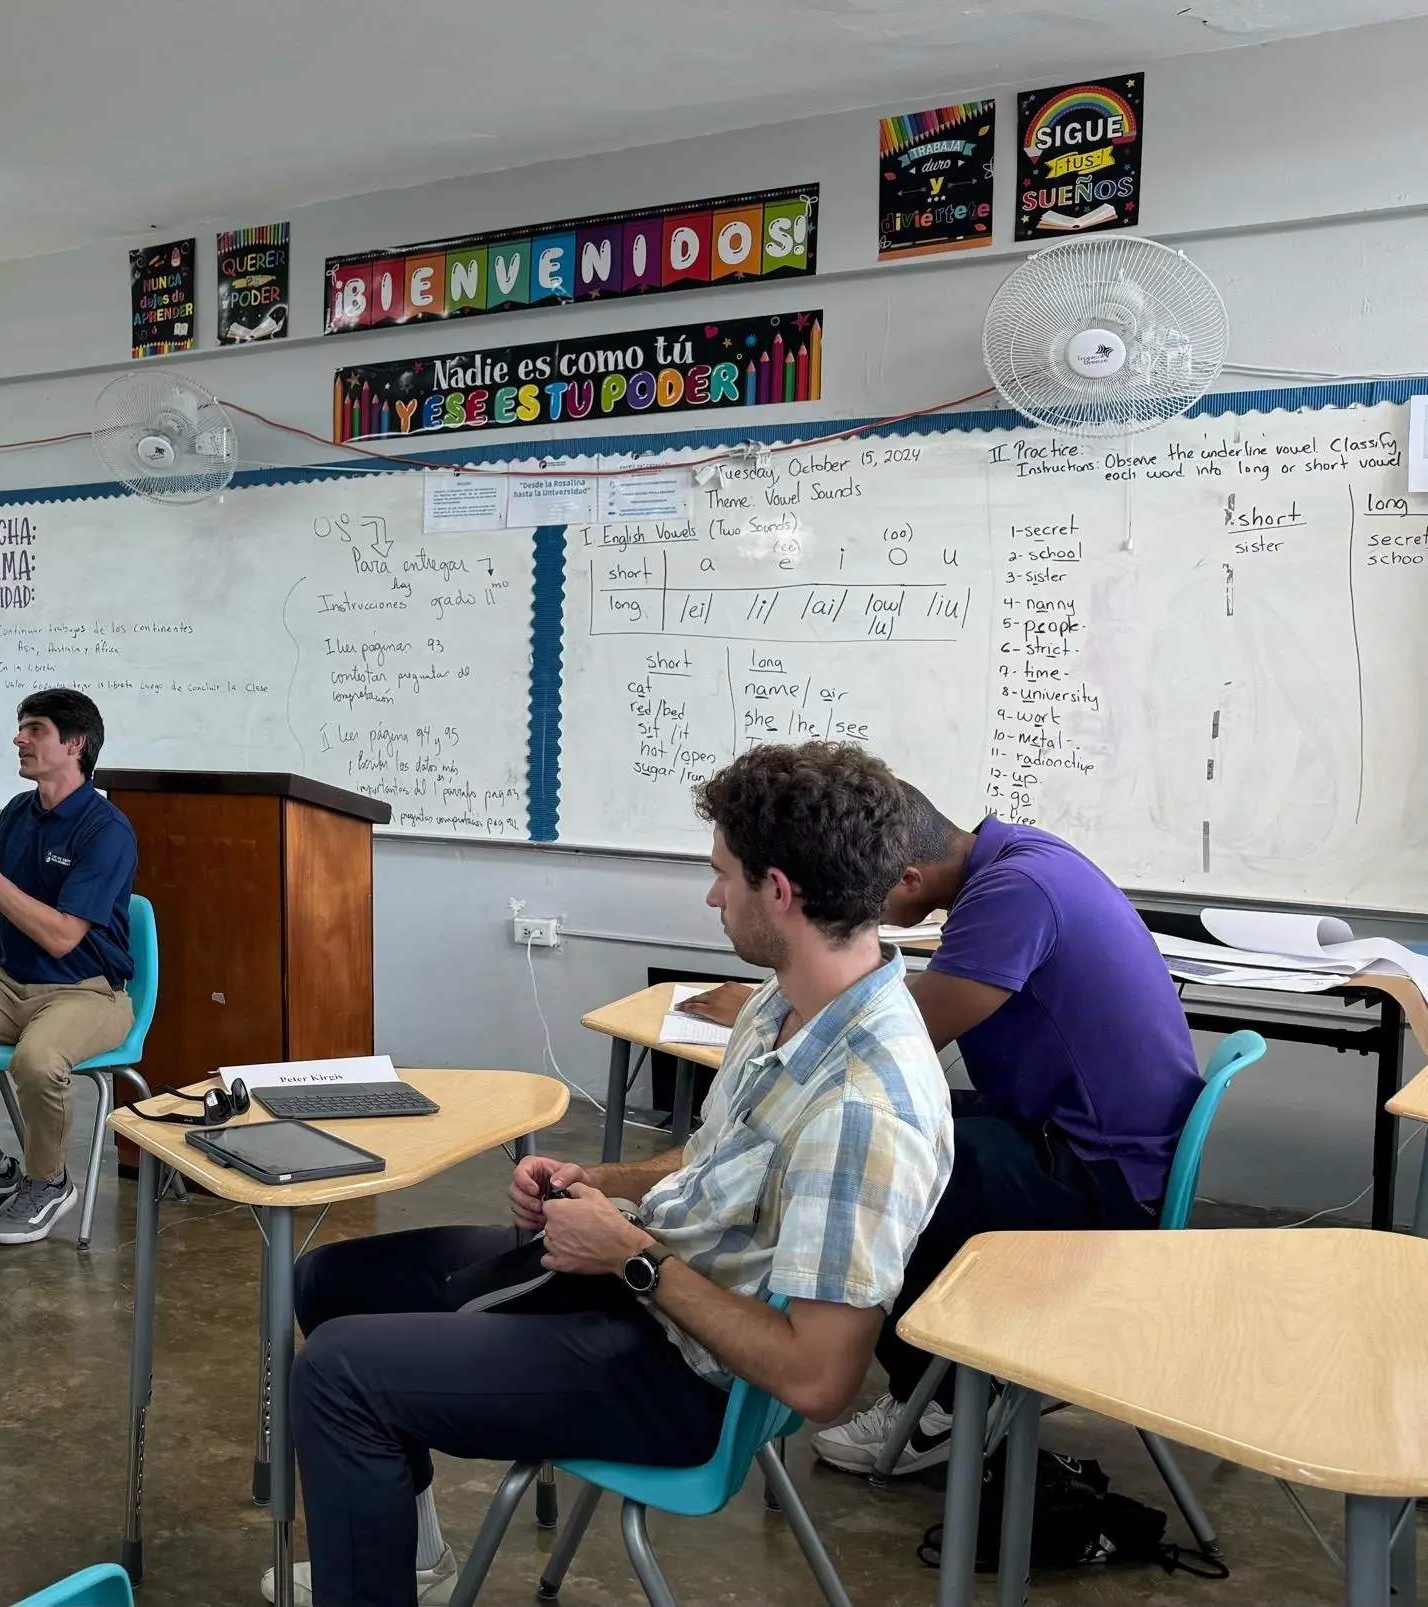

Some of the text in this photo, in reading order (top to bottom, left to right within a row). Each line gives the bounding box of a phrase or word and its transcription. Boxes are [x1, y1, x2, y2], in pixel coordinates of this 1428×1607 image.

[1036, 115, 1123, 150] SIGUE
[911, 141, 961, 158] TRABAJA
[922, 158, 951, 171] duro
[1064, 155, 1094, 172] tus
[930, 177, 944, 195] y
[1022, 175, 1134, 211] SUEÑOS
[881, 202, 990, 234] diviértete
[222, 251, 285, 276] QUERER
[335, 214, 806, 318] ¡BIENVENIDOS!
[143, 273, 181, 293] NUNCA
[140, 289, 185, 309] dejes de
[230, 286, 281, 308] PODER
[133, 302, 193, 326] APRENDER
[432, 334, 695, 391] Nadie es como tú
[395, 362, 740, 434] Y ESE ES TU PODER
[1013, 439, 1085, 459] Practice:
[1017, 460, 1100, 478] Instructions:
[1105, 453, 1157, 470] Observe
[1168, 443, 1194, 461] the
[1200, 439, 1268, 460] underline
[1330, 431, 1397, 456] Classify
[788, 455, 850, 477] October
[883, 448, 921, 463] 2024
[1105, 451, 1401, 481] each word into long or short vowel
[514, 490, 532, 498] hasta
[535, 489, 541, 497] la
[546, 480, 552, 488] la
[554, 479, 585, 487] Rosalina
[705, 489, 755, 509] Theme:
[765, 481, 800, 508] Vowel
[811, 476, 862, 501] Sounds
[1238, 501, 1301, 527] short
[1368, 493, 1409, 518] long
[603, 525, 645, 552] English
[656, 520, 696, 540] Vowels
[710, 519, 741, 540] (Two
[749, 512, 797, 534] Sounds)
[883, 522, 913, 542] (oo)
[1029, 541, 1082, 560] school
[1235, 535, 1284, 554] sister
[352, 547, 469, 582] Para entregar
[608, 557, 653, 584] short
[700, 557, 716, 572] a
[778, 557, 795, 570] e
[839, 548, 845, 570] i
[1368, 552, 1423, 566] schoo
[1026, 567, 1067, 582] sister
[317, 590, 476, 620] Instrucciones grado
[609, 595, 642, 621] long
[1027, 599, 1075, 616] nanny
[93, 621, 105, 634] de
[112, 622, 125, 634] los
[427, 638, 444, 653] 93
[646, 649, 693, 668] short
[752, 649, 783, 671] long
[331, 665, 388, 685] contestar
[628, 676, 652, 694] cat
[228, 681, 236, 691] la
[820, 686, 848, 700] air
[1021, 683, 1099, 711] university
[638, 722, 660, 738] sit
[435, 737, 441, 756] y
[445, 726, 460, 746] 95
[641, 741, 667, 758] hot
[396, 750, 409, 771] los
[416, 755, 437, 773] datos
[633, 762, 675, 782] sugar
[1011, 791, 1030, 809] go
[280, 1073, 343, 1083] Peter Kirgis
